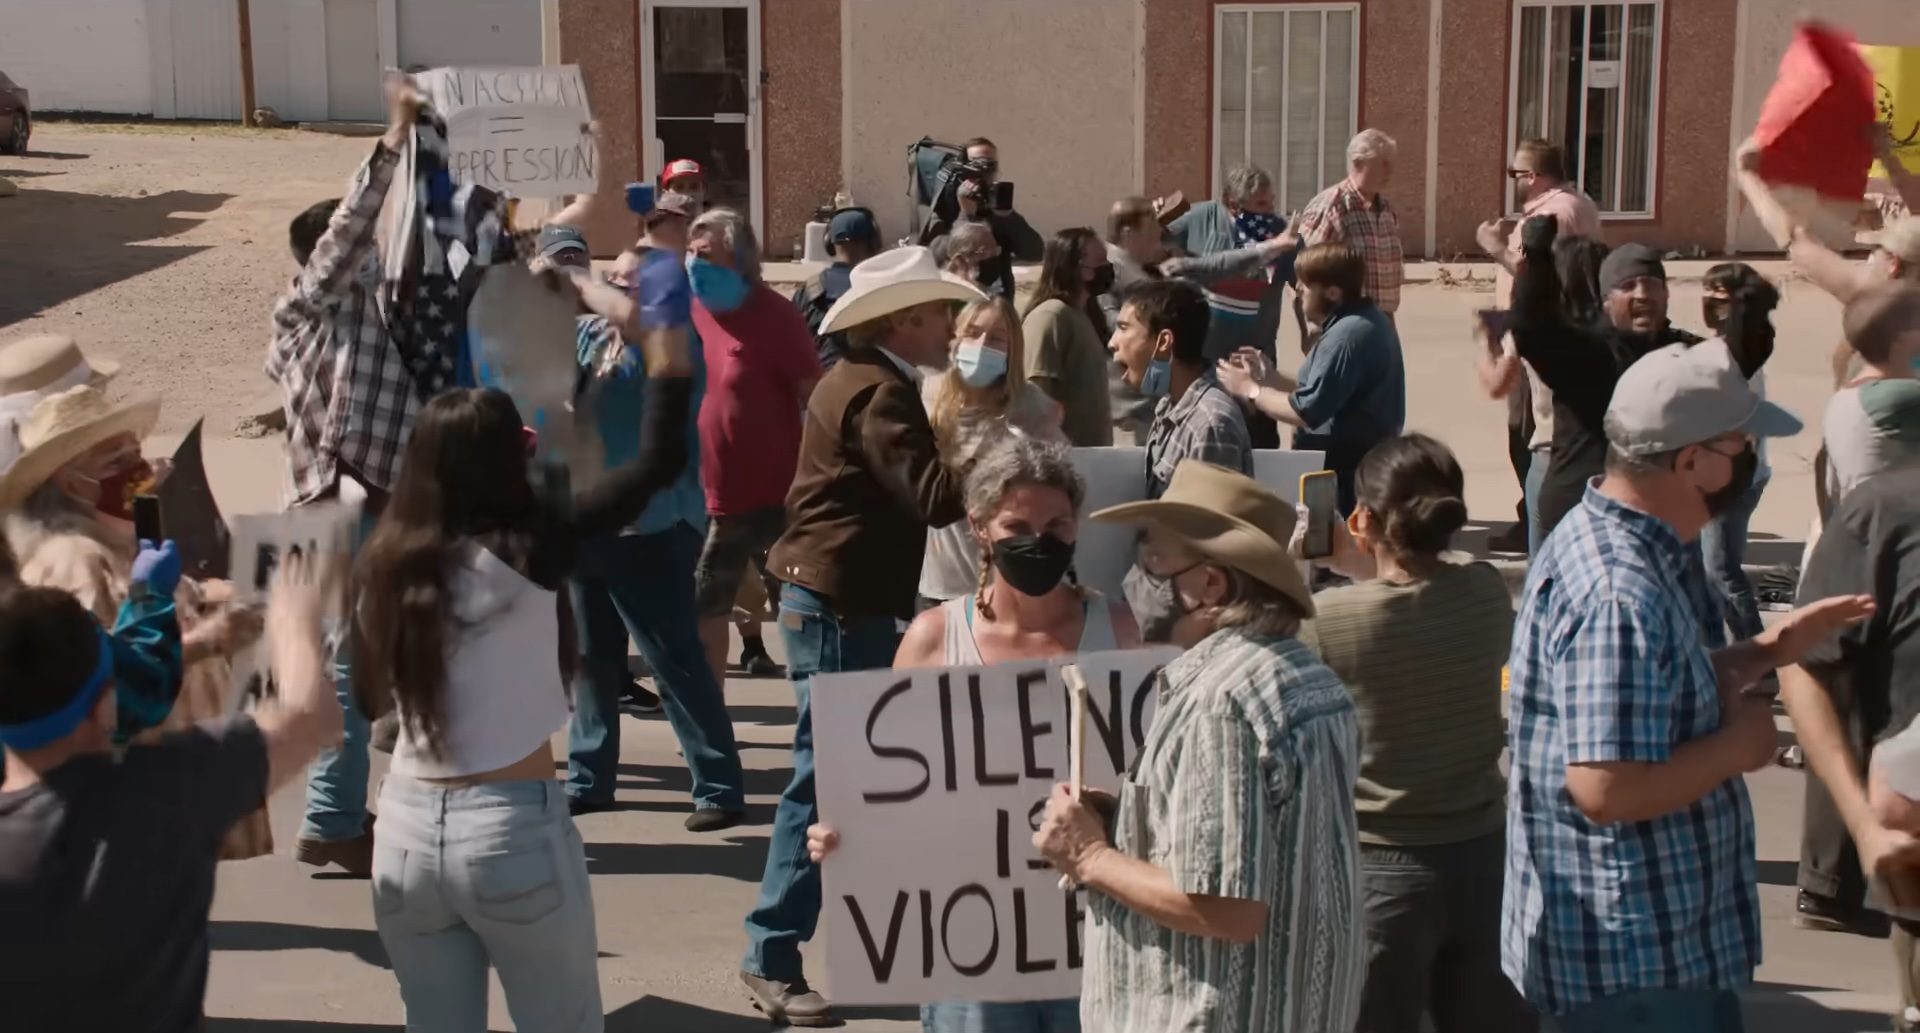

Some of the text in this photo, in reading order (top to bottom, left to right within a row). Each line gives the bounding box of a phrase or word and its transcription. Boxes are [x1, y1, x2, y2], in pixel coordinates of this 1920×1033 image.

[449, 143, 593, 184] PPRESSION
[863, 664, 1167, 803] SILENC
[843, 881, 1085, 984] VIOLE
